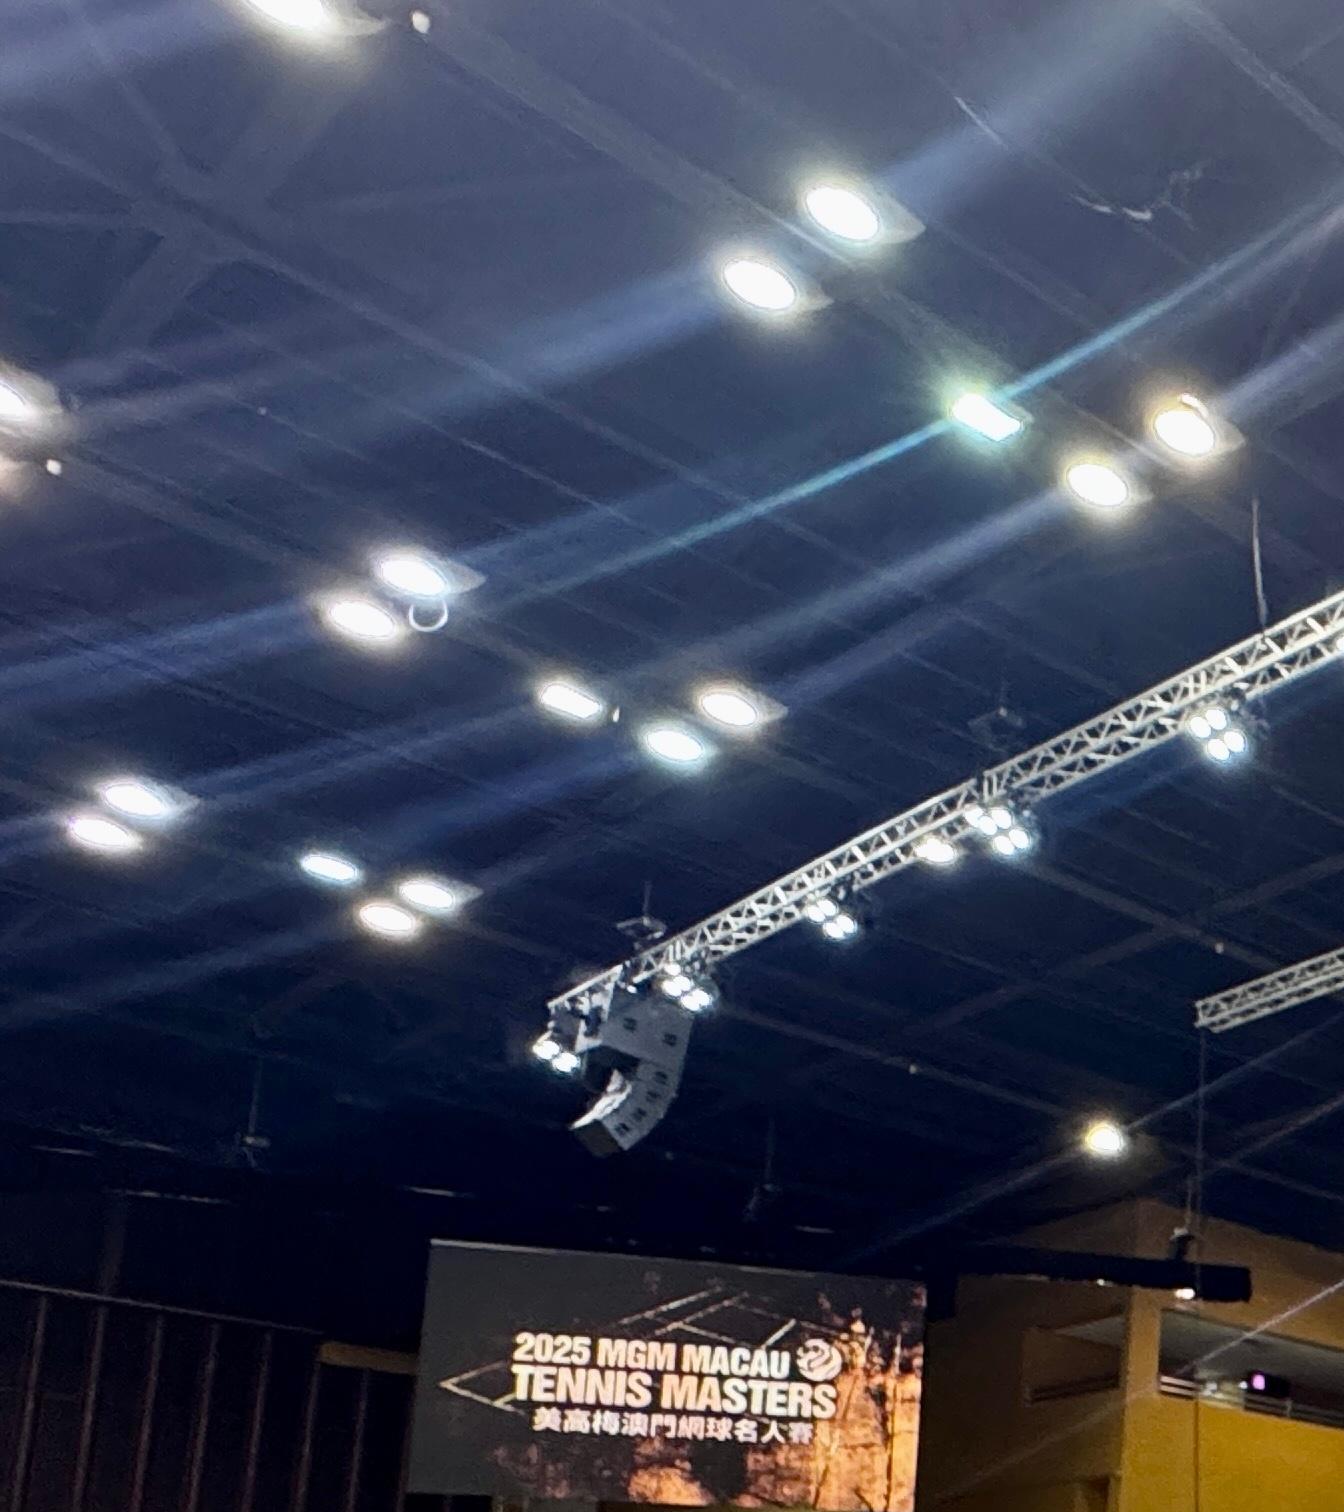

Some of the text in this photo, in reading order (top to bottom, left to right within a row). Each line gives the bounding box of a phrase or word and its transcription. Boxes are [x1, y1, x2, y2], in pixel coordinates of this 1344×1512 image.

[512, 1332, 790, 1379] 2025 MGM MACAU
[511, 1364, 838, 1420] TENNIS MASTERS
